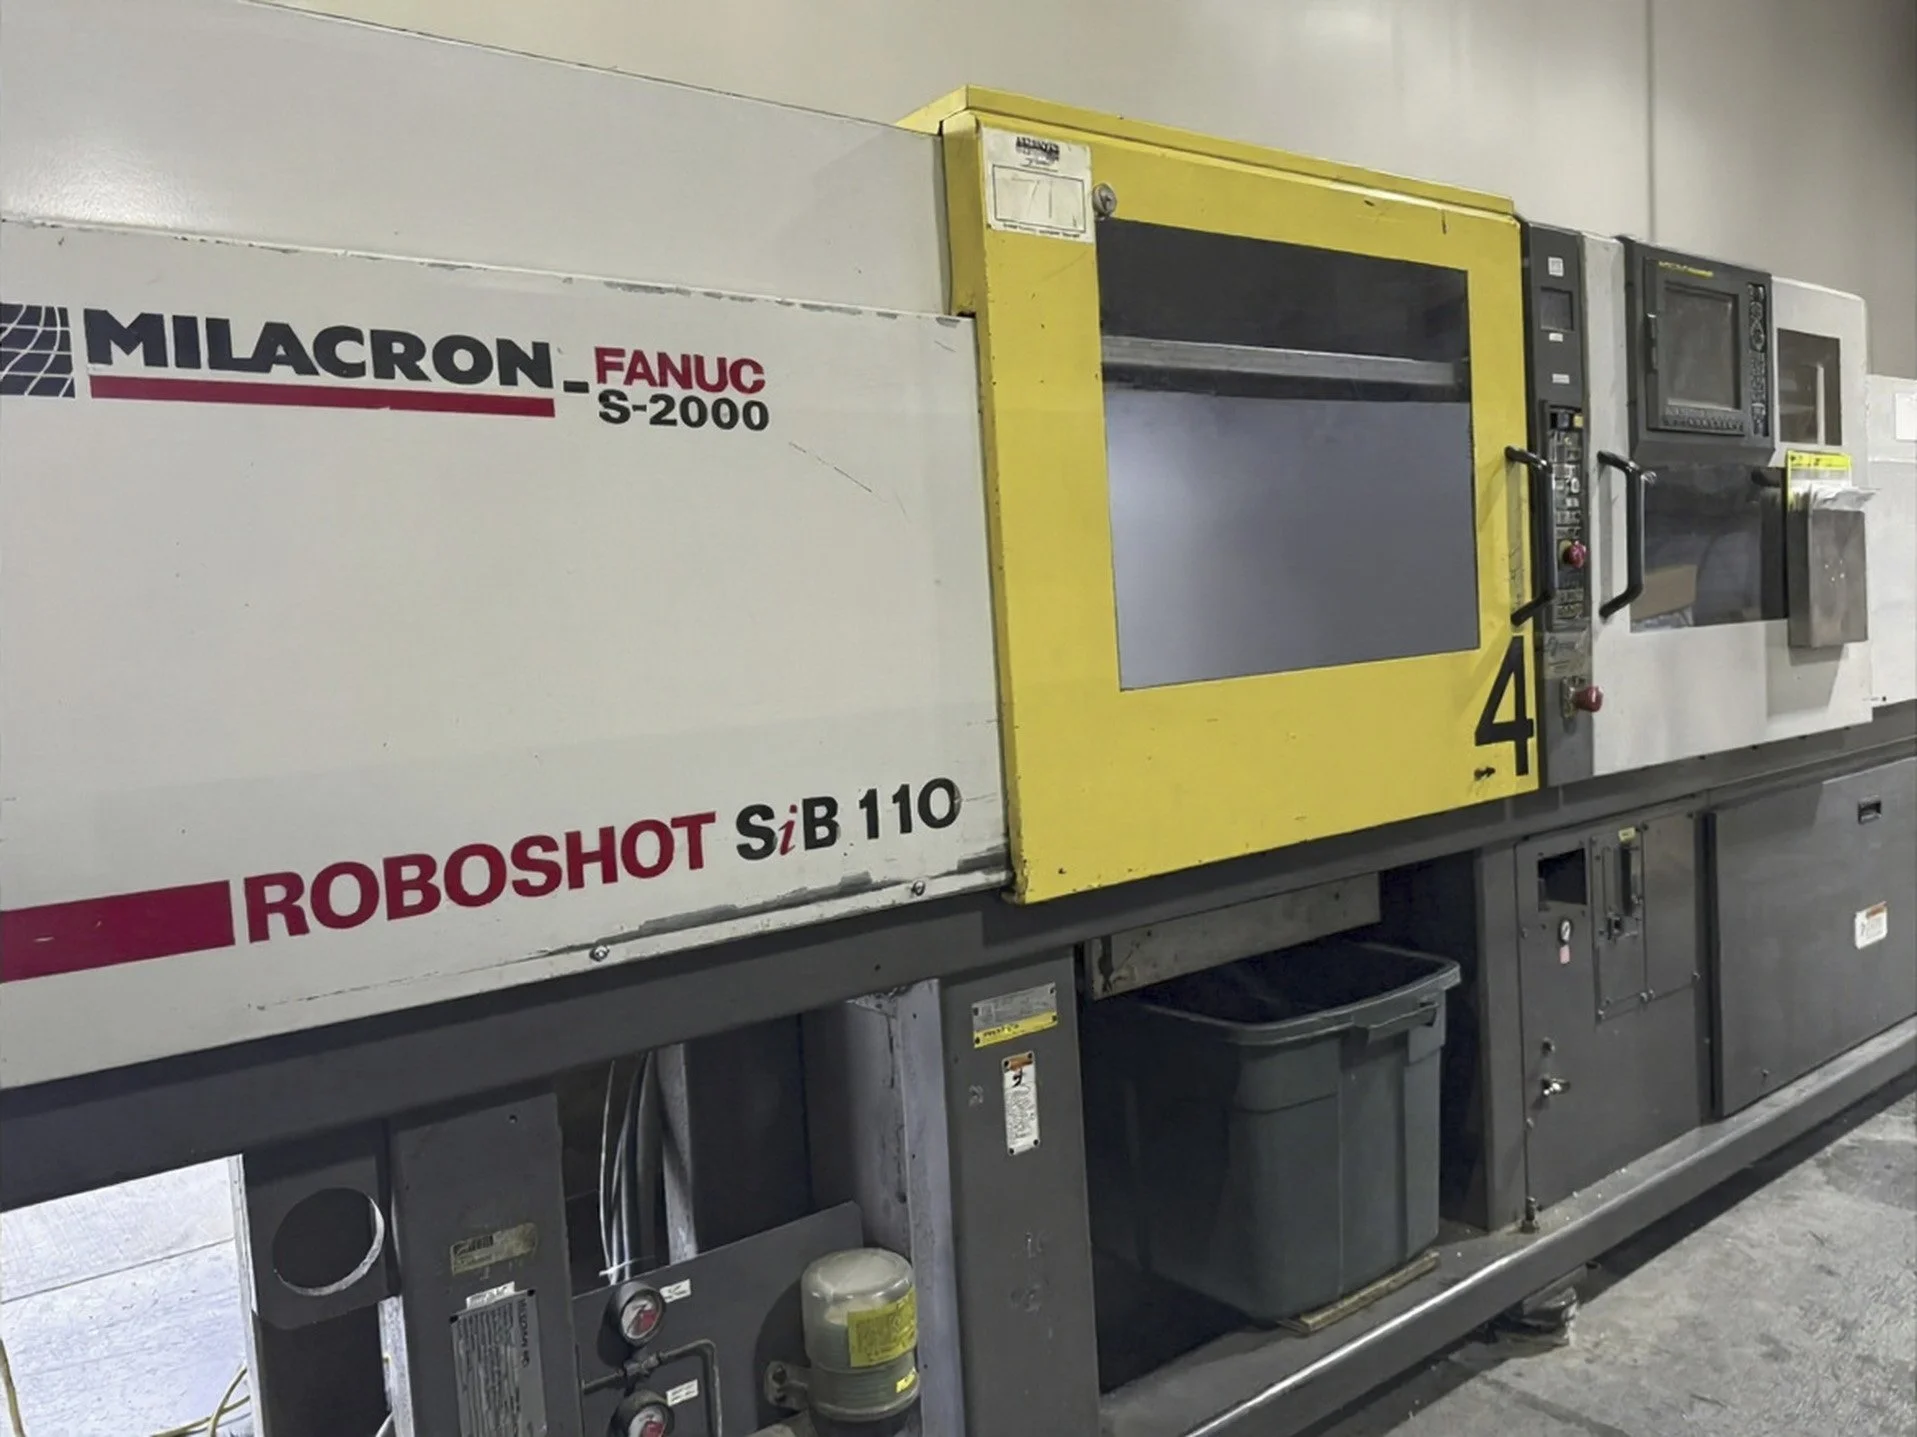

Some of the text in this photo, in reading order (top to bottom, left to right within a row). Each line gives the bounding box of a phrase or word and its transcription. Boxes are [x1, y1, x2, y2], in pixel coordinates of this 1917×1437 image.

[83, 308, 554, 389] MILACRON
[594, 345, 766, 395] FANUC
[598, 388, 770, 431] S-2000
[1475, 635, 1534, 776] 4
[244, 777, 962, 943] ROBOSHOT SiB 110
